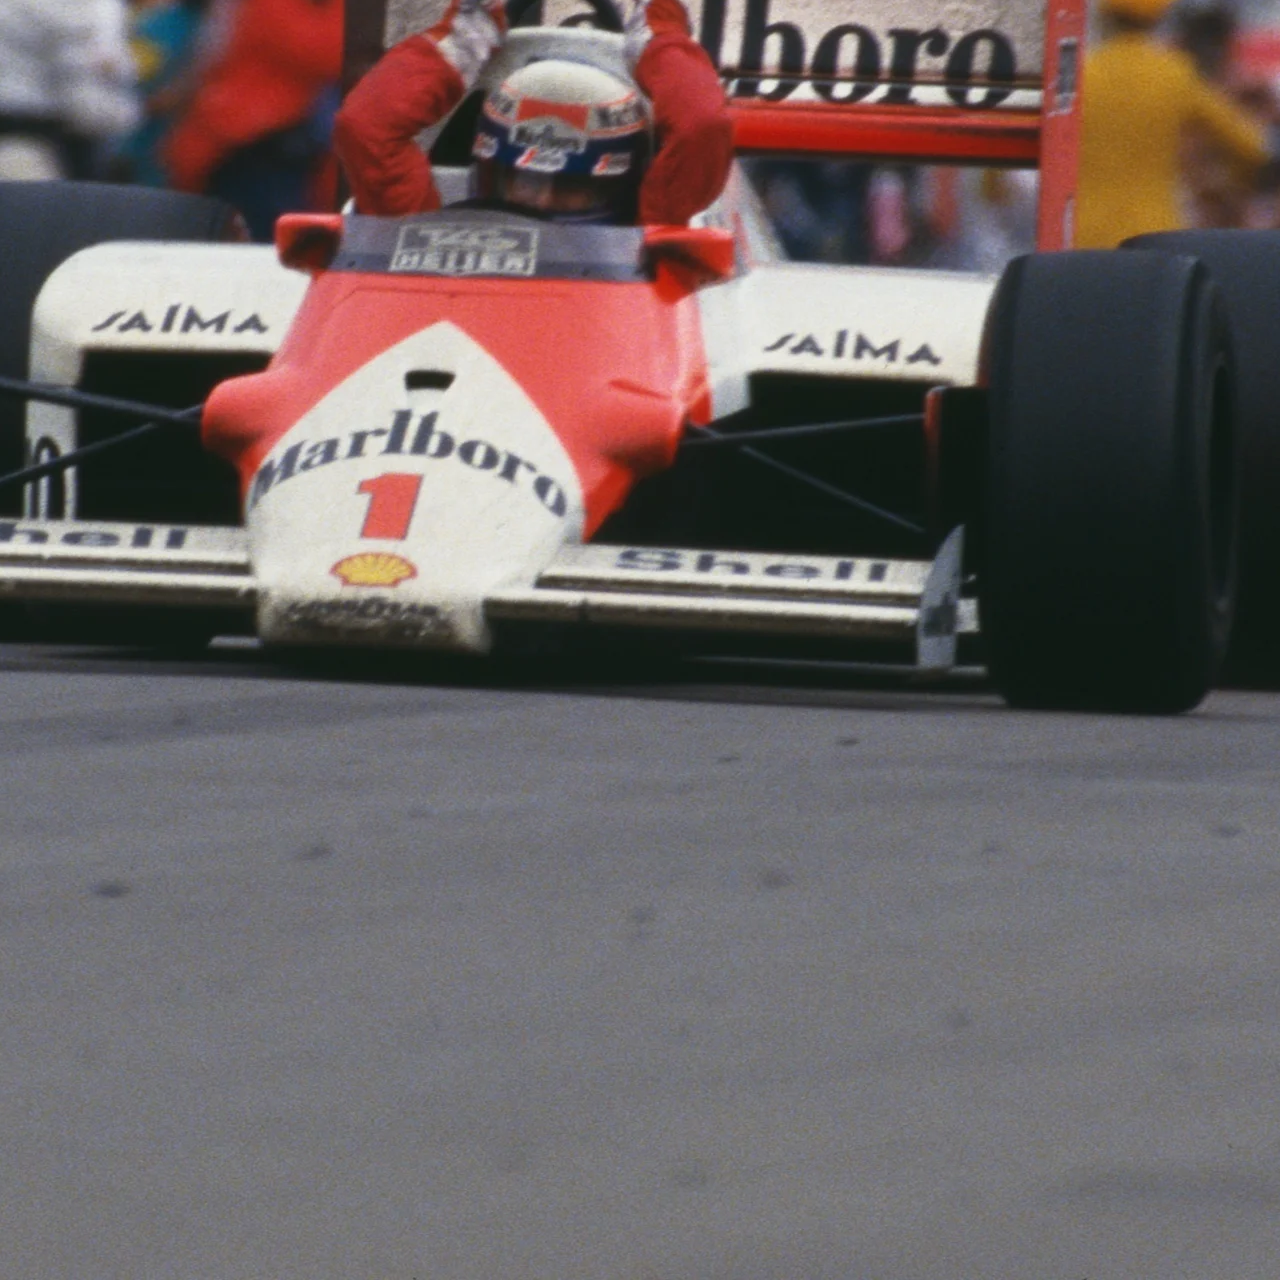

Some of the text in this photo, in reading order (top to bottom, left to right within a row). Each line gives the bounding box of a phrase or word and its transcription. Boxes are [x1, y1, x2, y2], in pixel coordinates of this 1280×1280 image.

[91, 302, 269, 333] SAIMA
[763, 328, 942, 365] SAIMA
[247, 408, 568, 518] Marlboro
[355, 472, 424, 540] 1
[615, 549, 889, 582] Shell
